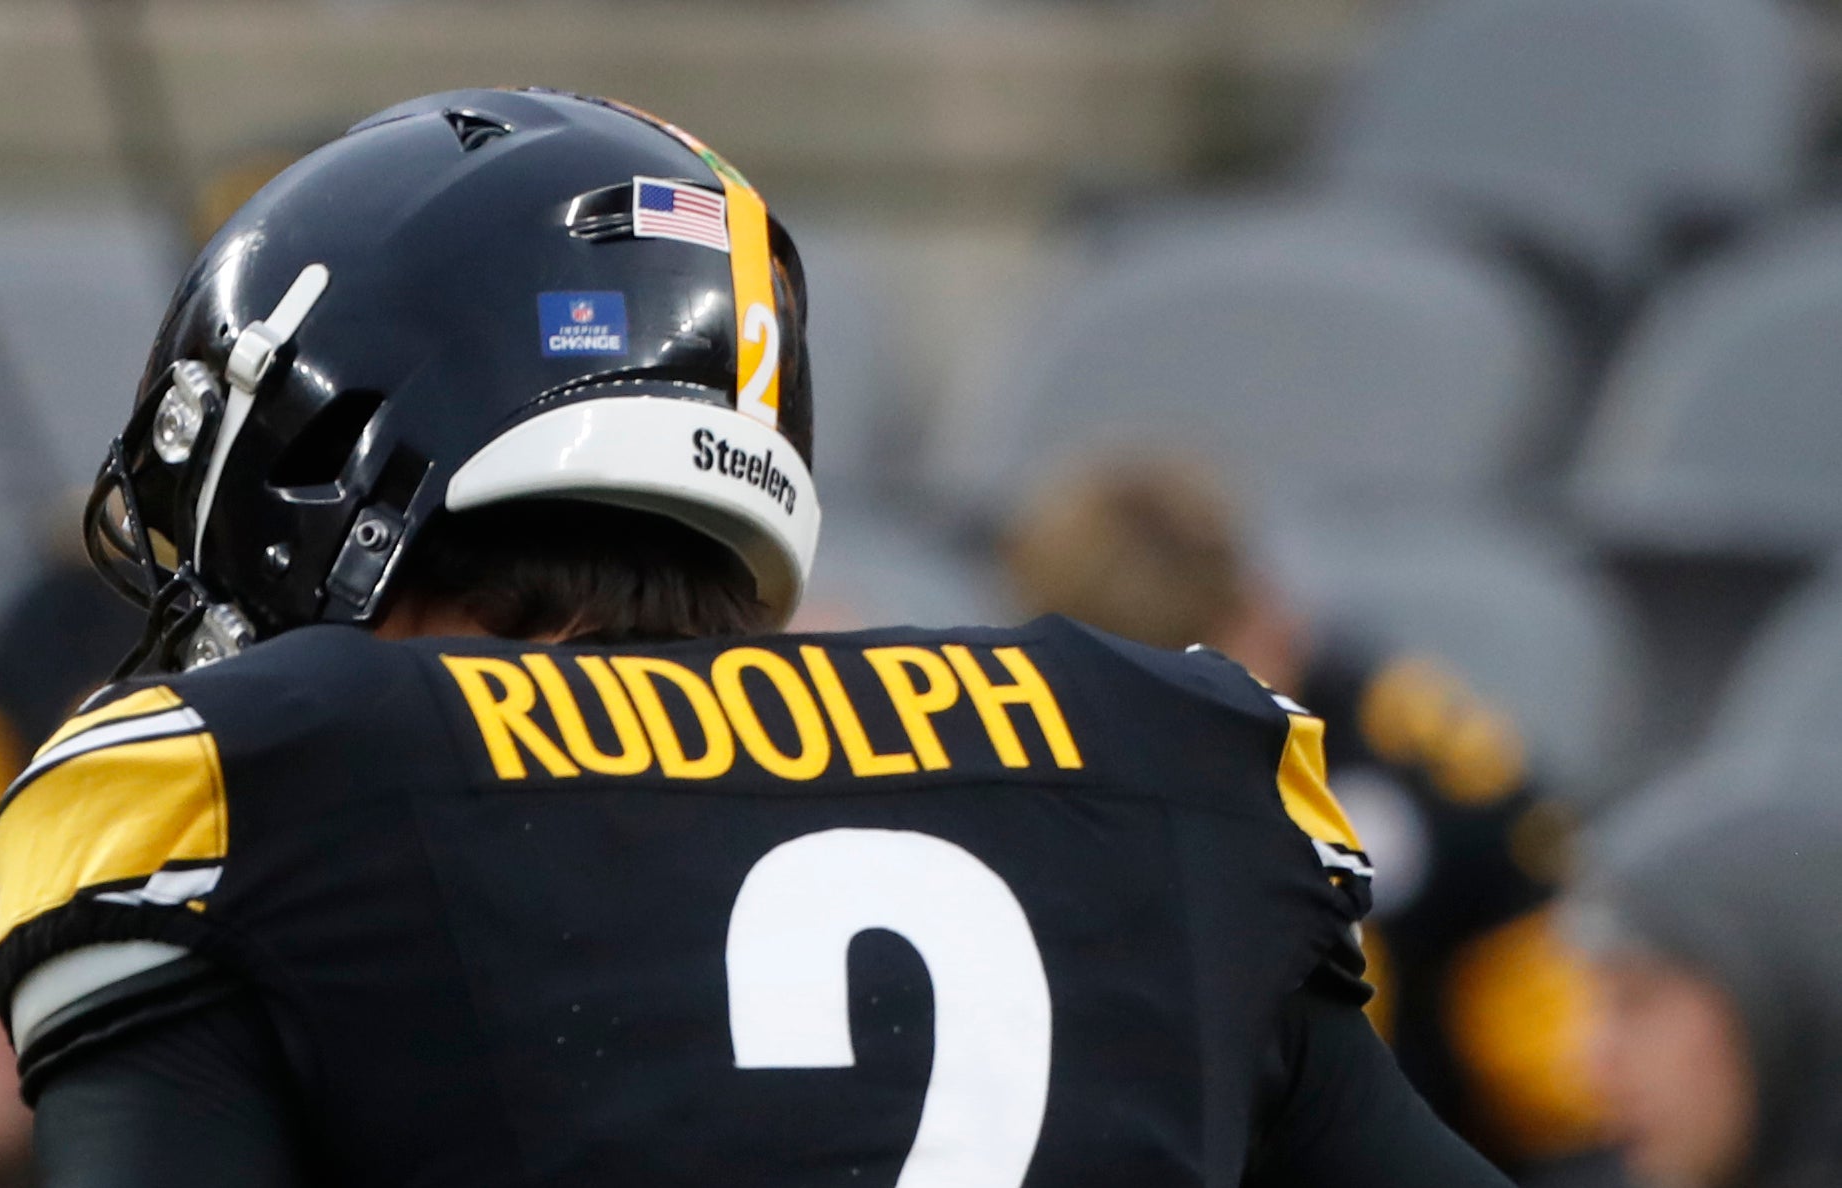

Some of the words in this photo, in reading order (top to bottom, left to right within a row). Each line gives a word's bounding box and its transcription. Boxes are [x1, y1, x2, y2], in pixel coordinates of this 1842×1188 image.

[548, 334, 622, 351] CHANGE
[559, 324, 609, 336] INSPIRE
[737, 302, 780, 430] 2
[692, 427, 797, 517] Steelers
[439, 643, 1084, 782] RUDOLPH
